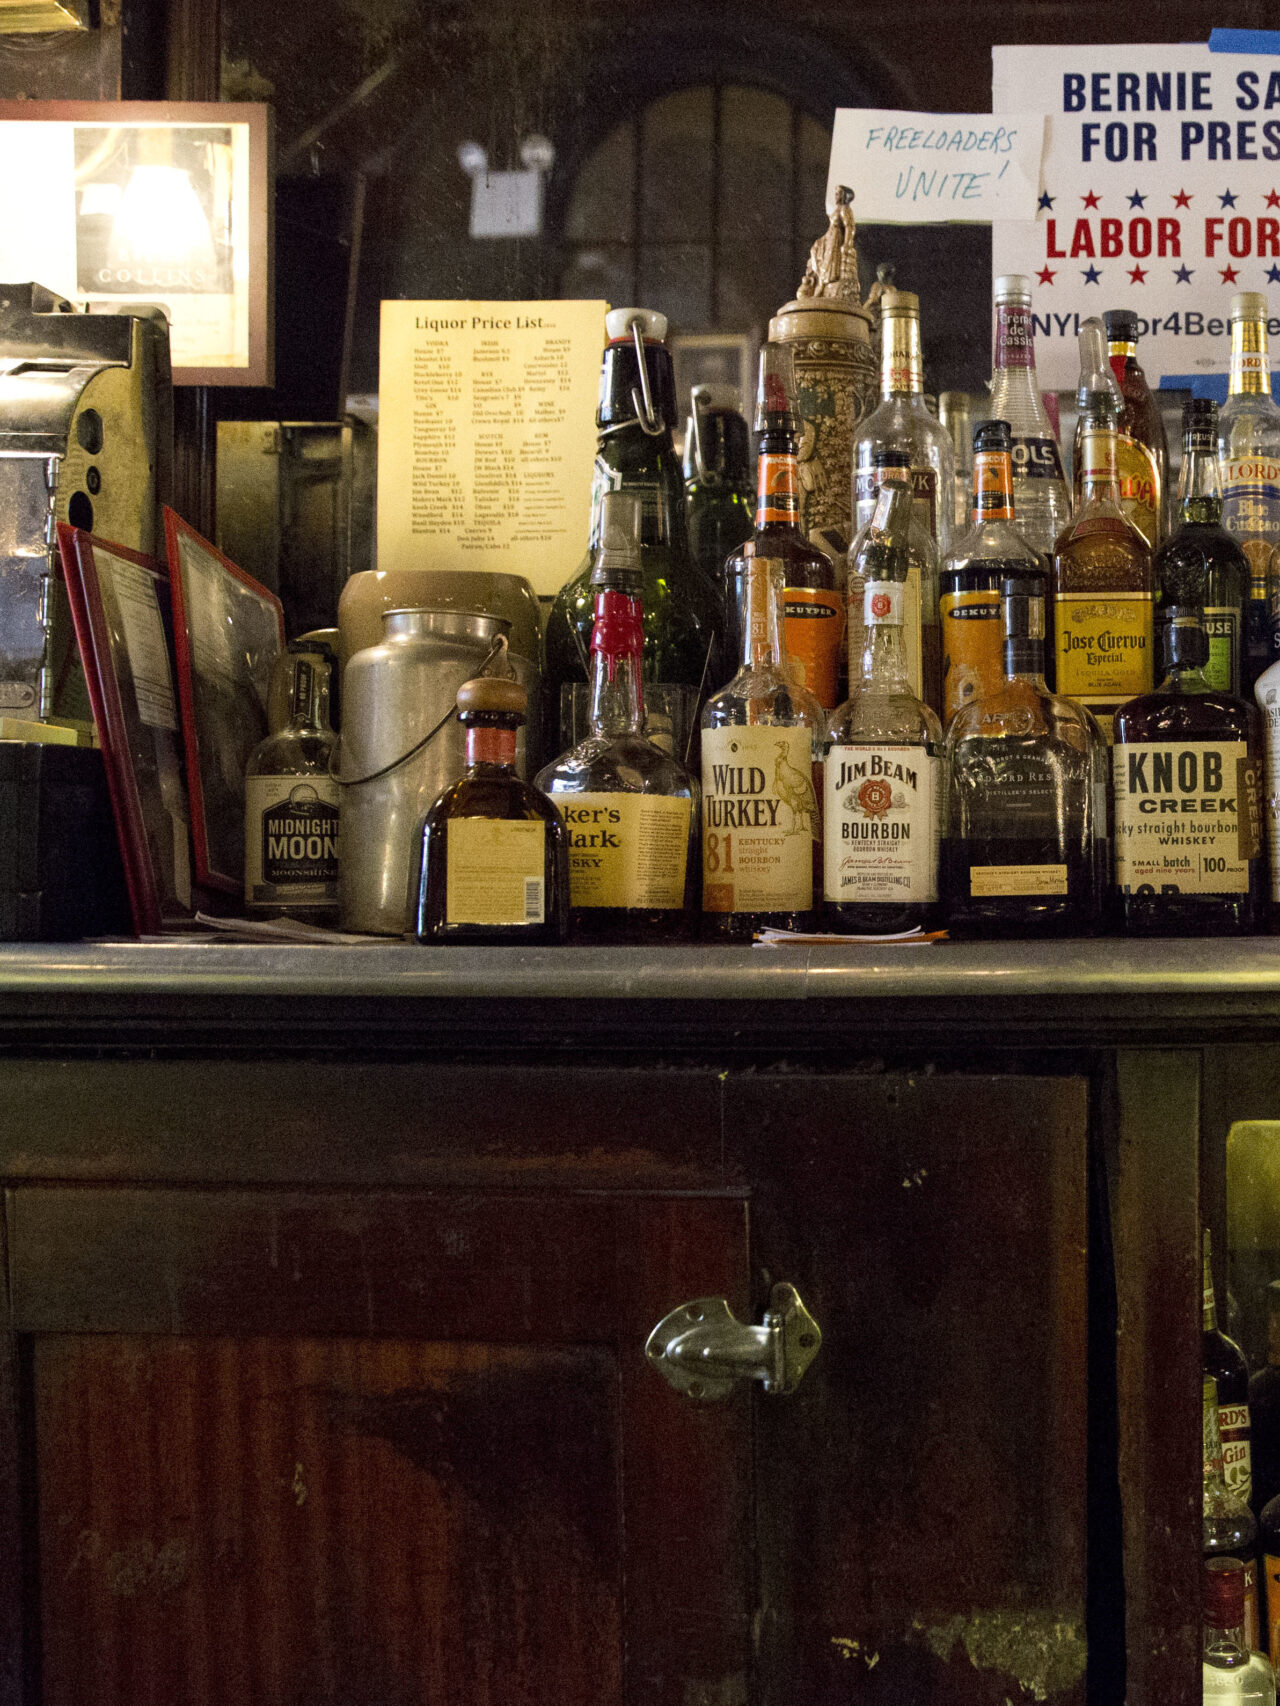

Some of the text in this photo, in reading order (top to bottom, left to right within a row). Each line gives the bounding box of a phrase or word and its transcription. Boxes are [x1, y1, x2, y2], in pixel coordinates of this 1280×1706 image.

[1063, 71, 1212, 112] BERNIE
[866, 126, 1017, 153] FREELOADERS
[1081, 122, 1157, 162] FOR
[1046, 217, 1182, 258] LABOR
[1204, 217, 1280, 258] FOR
[99, 268, 206, 284] COLLINS
[415, 316, 467, 332] Liquor
[471, 316, 512, 329] Price
[1011, 445, 1054, 465] OLS
[785, 606, 833, 616] KUYPER
[953, 607, 1000, 617] DEKUY
[1063, 630, 1146, 653] Jose Cuervo
[712, 764, 765, 795] WILD
[836, 755, 917, 791] JIM BEAM
[1129, 751, 1222, 793] KNOB
[564, 806, 621, 824] ker's
[705, 795, 780, 828] TURKEY
[1139, 799, 1237, 813] CREEK
[842, 823, 910, 839] BOURBON
[1137, 820, 1185, 837] straight
[1190, 820, 1237, 834] bourbon
[268, 836, 339, 860] MOON
[738, 838, 786, 846] KENTUCKY
[1159, 836, 1216, 846] WHISKEY
[708, 832, 734, 873] 81
[738, 856, 781, 864] BOURBON
[1163, 856, 1190, 868] batch
[1203, 857, 1226, 873] 100
[1219, 1409, 1248, 1426] RD'S
[1223, 1446, 1246, 1464] Gin
